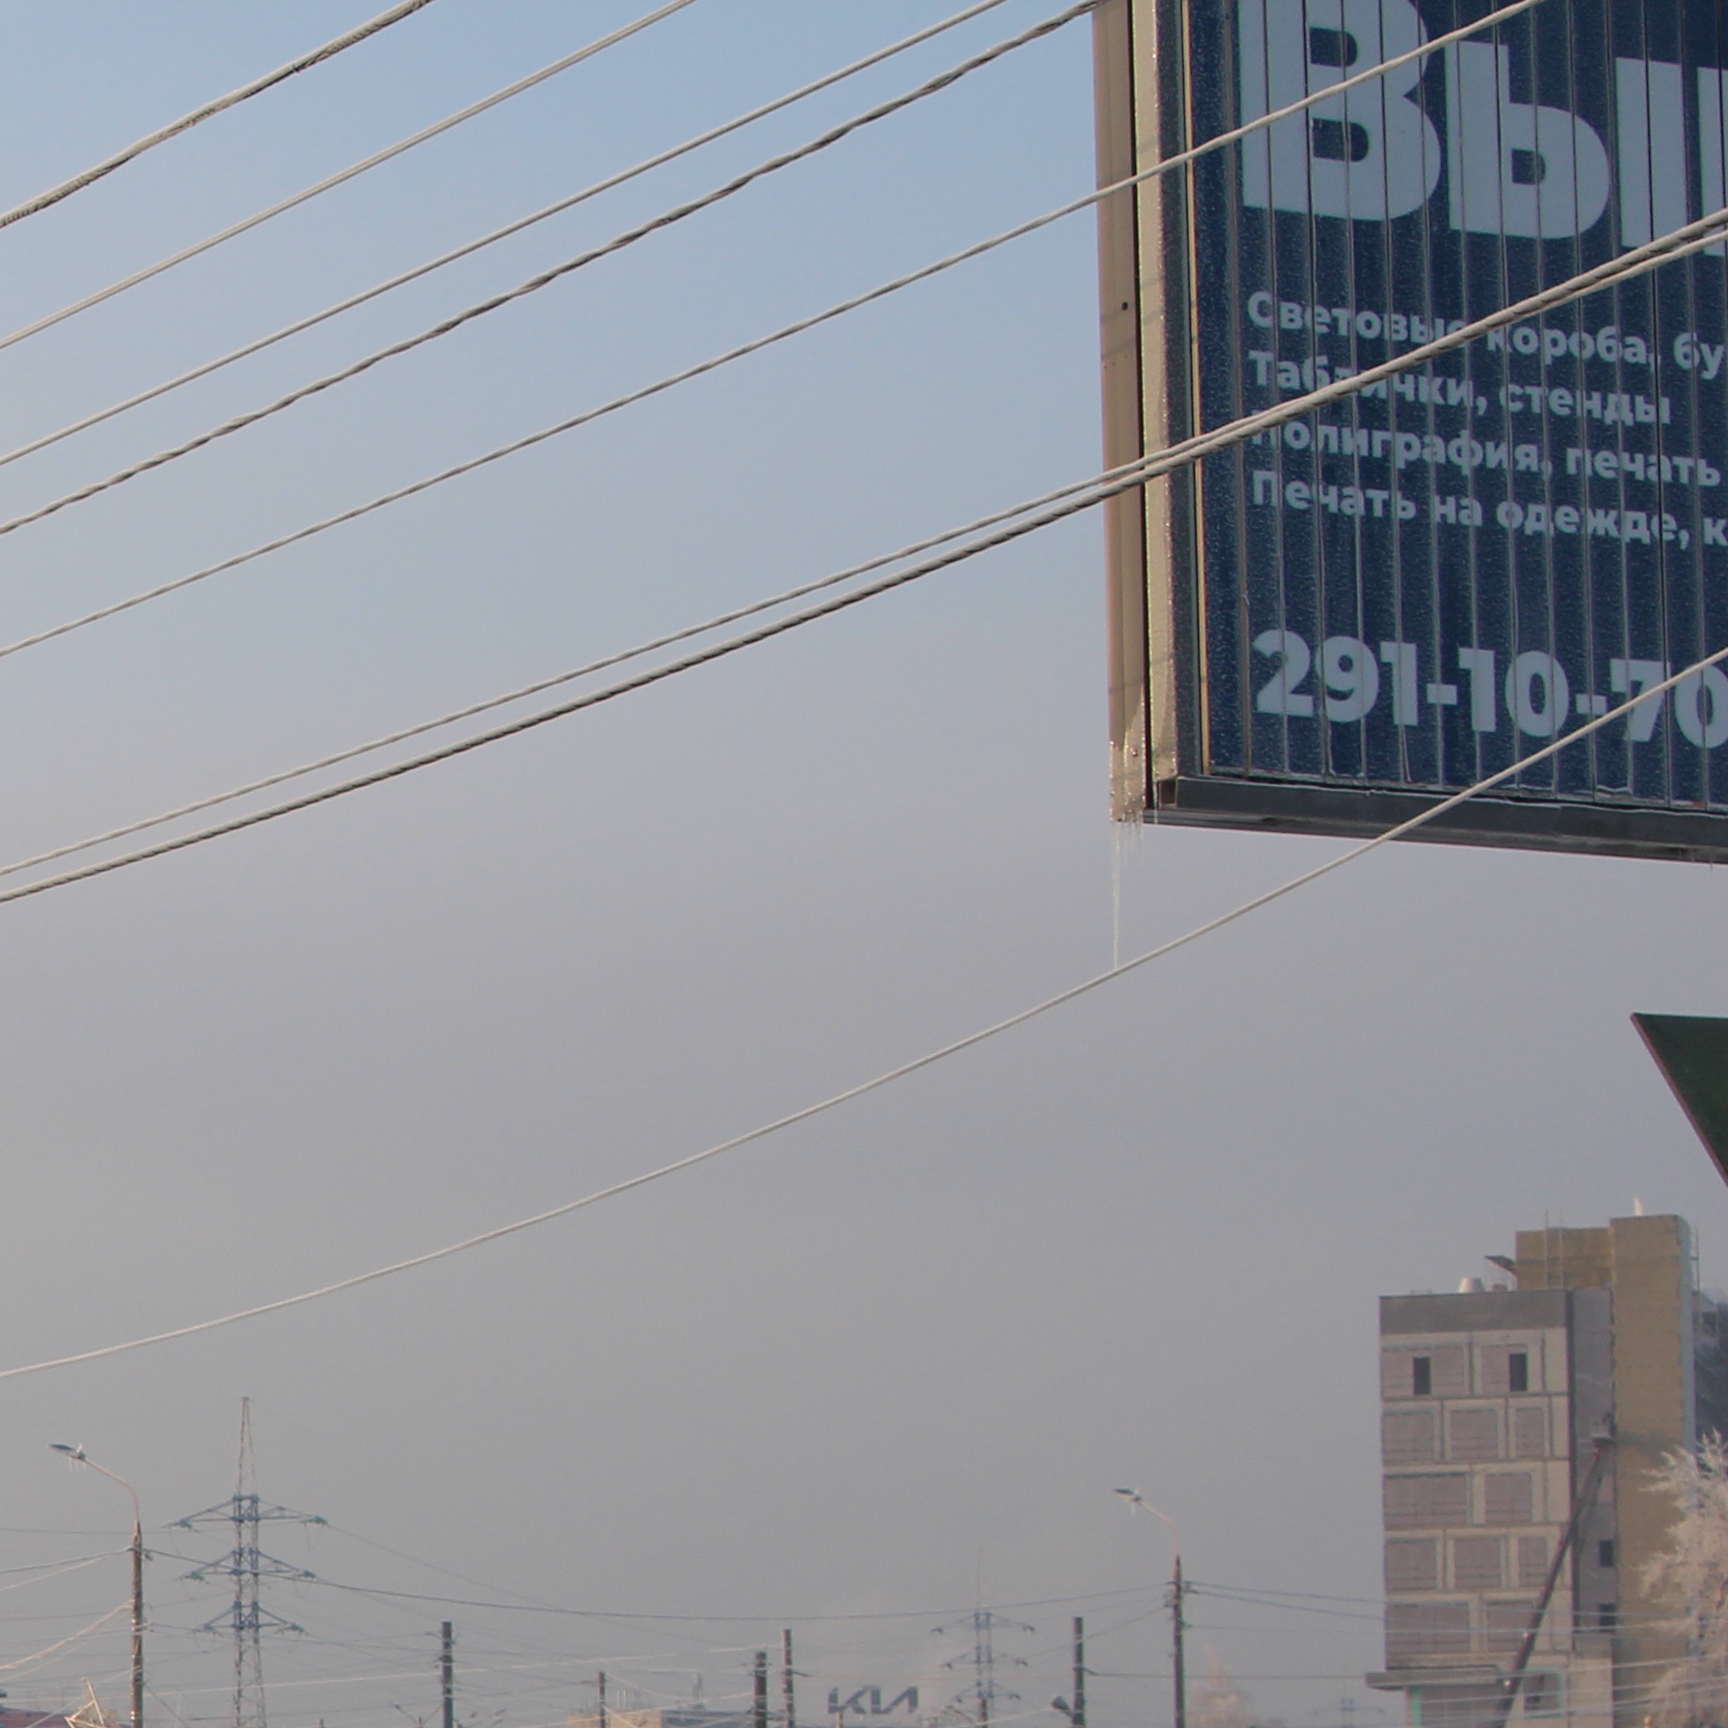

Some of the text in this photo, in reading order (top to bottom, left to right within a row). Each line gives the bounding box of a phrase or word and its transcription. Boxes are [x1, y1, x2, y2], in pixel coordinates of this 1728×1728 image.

[1239, 0, 1728, 258] ВЫ
[1487, 325, 1661, 374] короба,
[1673, 332, 1725, 381] бу
[1499, 383, 1671, 426] стенды
[1566, 447, 1721, 487] печать
[1252, 470, 1416, 520] Печать
[1434, 495, 1483, 527] на
[1496, 500, 1690, 550] одежде,
[1253, 629, 1728, 749] 291-10-70
[828, 1685, 919, 1714] KIA
